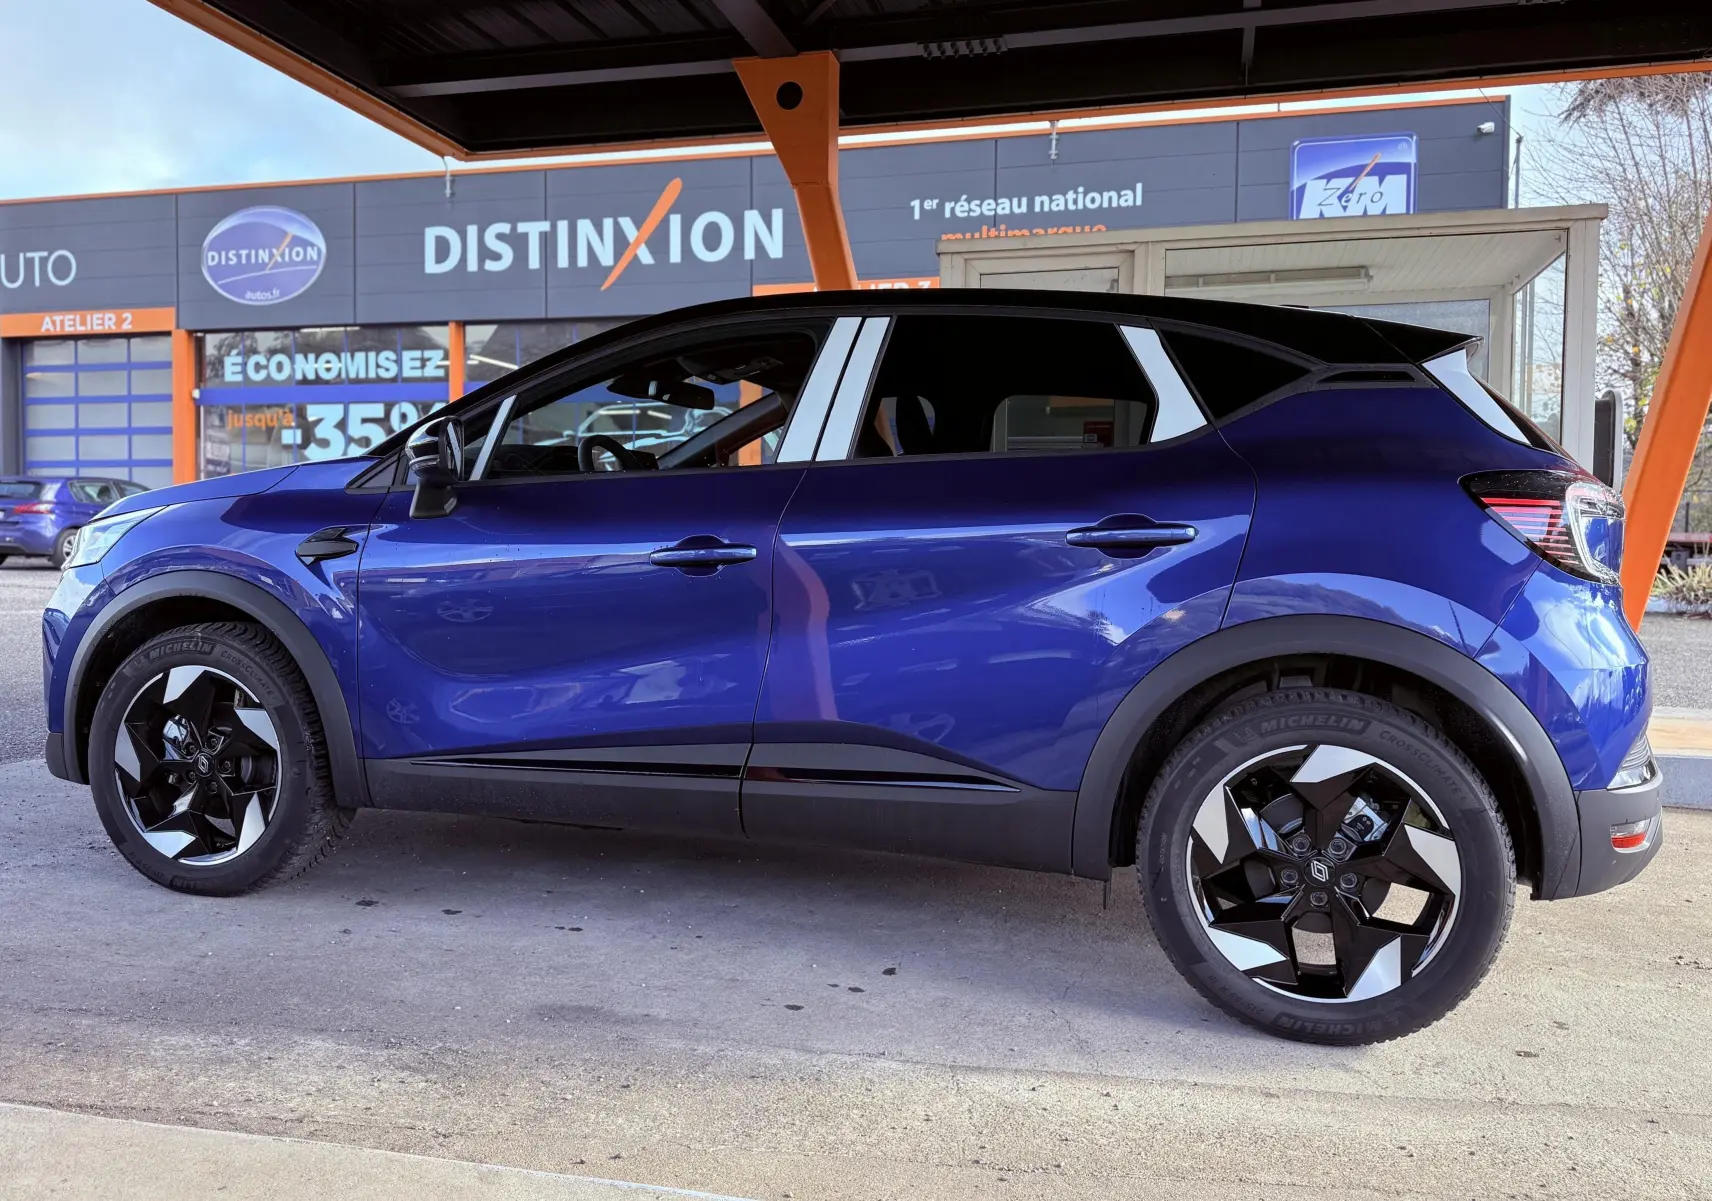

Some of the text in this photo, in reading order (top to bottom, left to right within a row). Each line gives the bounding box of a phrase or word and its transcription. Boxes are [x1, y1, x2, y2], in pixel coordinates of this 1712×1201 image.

[910, 182, 1143, 220] 1er réseau national
[1316, 187, 1384, 206] Zero
[424, 177, 784, 291] DISTINXION
[207, 239, 318, 272] DISTINXION
[244, 288, 280, 300] autos.fr
[41, 312, 133, 332] ATELIER 2
[223, 349, 445, 382] ÉCONOMISEZ
[227, 408, 294, 431] jusqu'à
[150, 640, 213, 660] MICHELIN
[1260, 713, 1365, 733] MICHELIN
[1378, 729, 1460, 795] CROSSCLIMATE
[1276, 1012, 1384, 1036] MICHELIN
